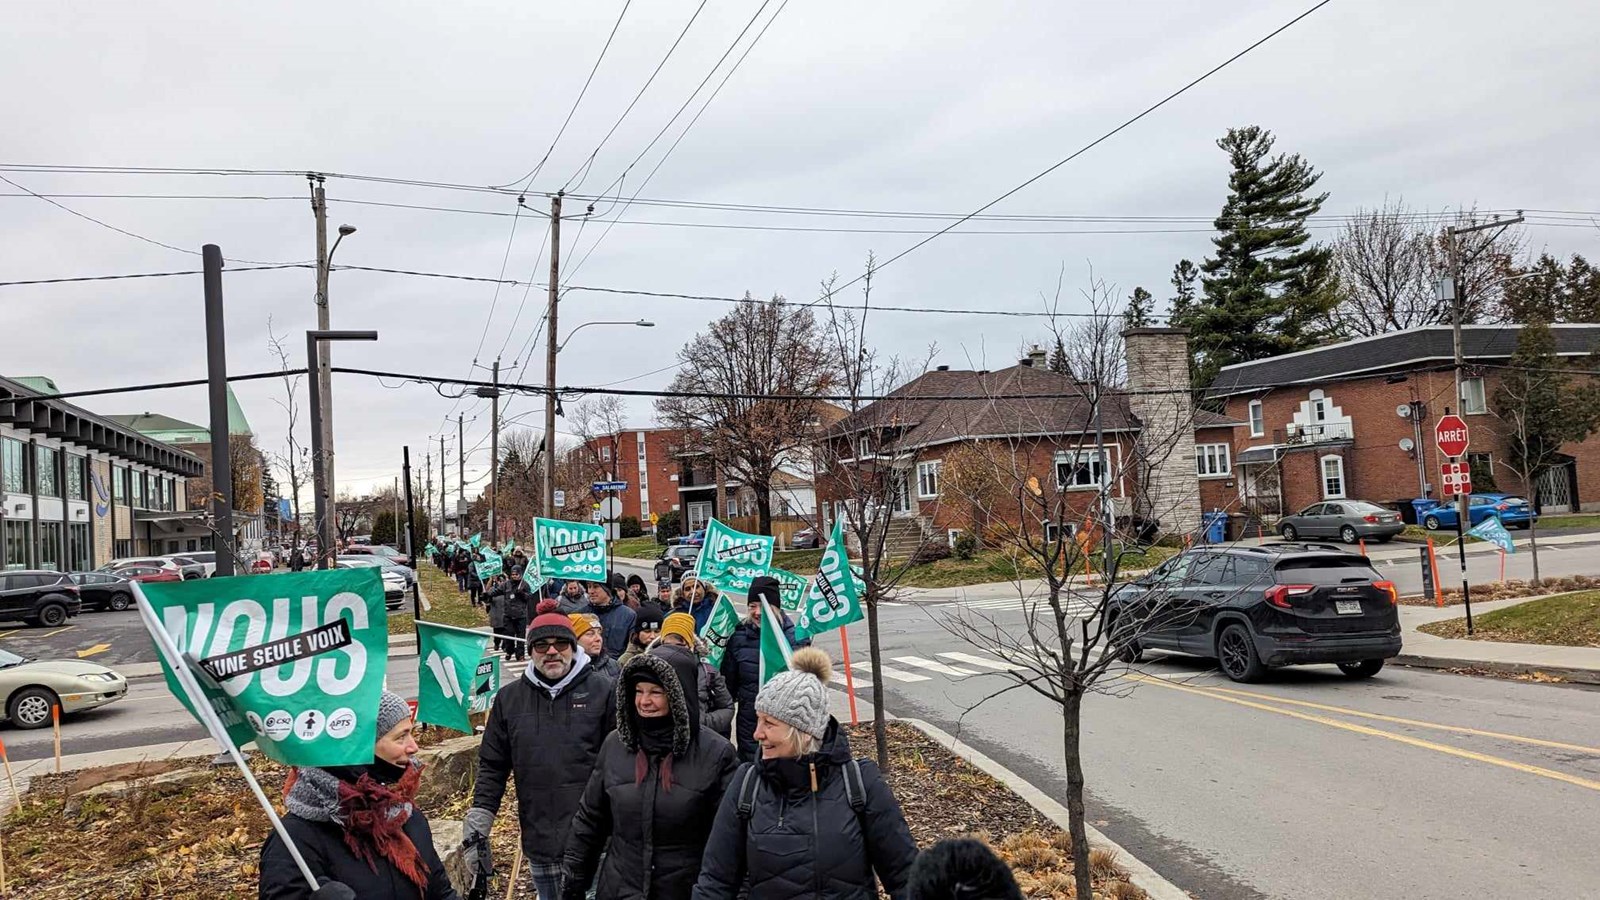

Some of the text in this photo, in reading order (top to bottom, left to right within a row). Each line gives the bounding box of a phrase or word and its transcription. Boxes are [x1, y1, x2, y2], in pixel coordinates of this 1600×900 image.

[1438, 428, 1466, 442] ARRÊT
[707, 526, 768, 565] NOUS
[253, 637, 302, 667] SEULE
[307, 624, 346, 652] VOIX
[329, 718, 351, 728] APTS
